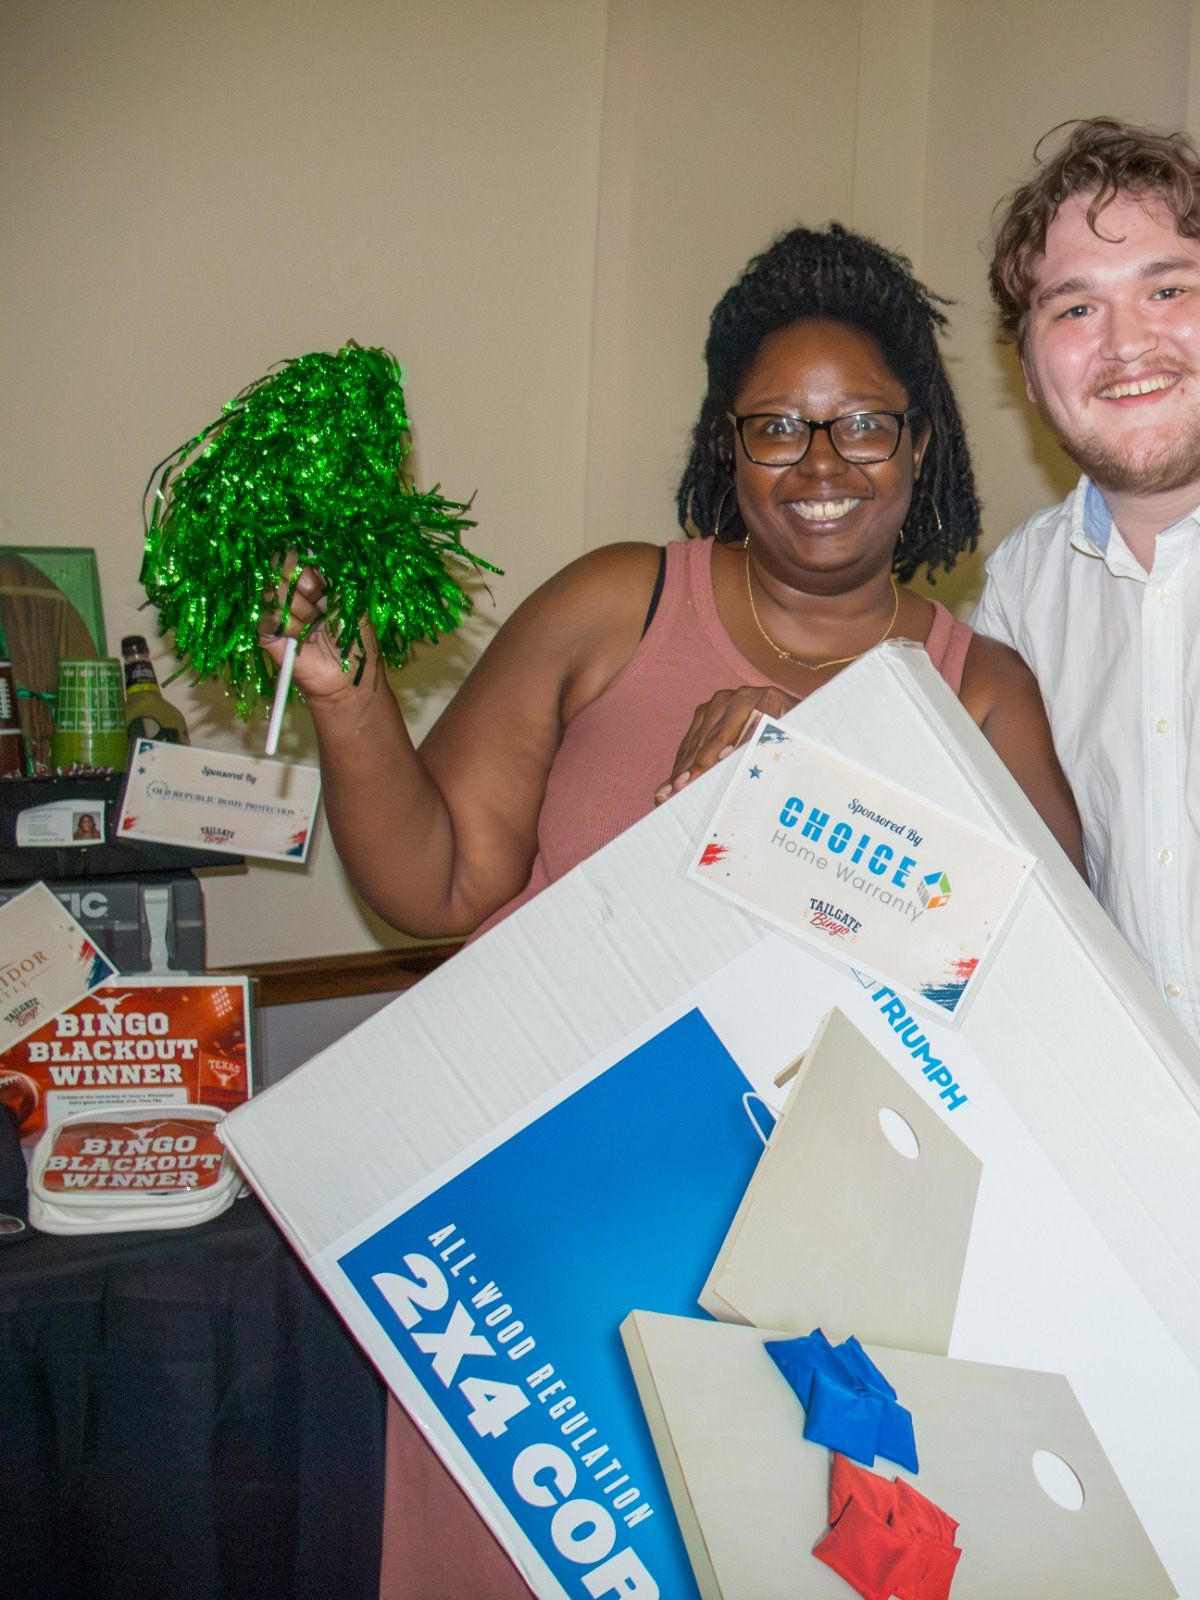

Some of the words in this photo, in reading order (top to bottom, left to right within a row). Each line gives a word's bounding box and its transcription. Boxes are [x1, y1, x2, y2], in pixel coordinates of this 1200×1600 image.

[202, 766, 244, 782] Sponsored
[246, 773, 258, 785] By
[152, 786, 172, 797] OLD
[173, 790, 216, 804] REPUBLIC
[217, 796, 243, 809] HOME
[245, 802, 295, 817] PROTECTION
[200, 826, 235, 840] TAILGATE
[847, 798, 905, 837] Sponsored
[906, 827, 924, 848] By
[778, 796, 918, 889] CHOICE
[771, 829, 829, 871] Home
[834, 860, 925, 924] Warranty
[809, 898, 863, 935] TAILGATE
[809, 911, 850, 938] Bingo
[0, 950, 48, 989] IDOR
[4, 996, 41, 1023] TAILGATE
[55, 1011, 170, 1037] BINGO
[28, 1039, 198, 1063] BLACKOUT
[871, 985, 969, 1112] TRIUMPH
[49, 1063, 184, 1086] WINNER
[208, 1059, 241, 1074] TEXAS
[80, 1135, 198, 1155] BINGO
[46, 1154, 222, 1172] BLACKOUT
[62, 1171, 199, 1188] WINNER
[371, 1253, 532, 1440] 2X4
[428, 1223, 537, 1361] ALL-WOOD
[526, 1363, 655, 1528] REGULATION
